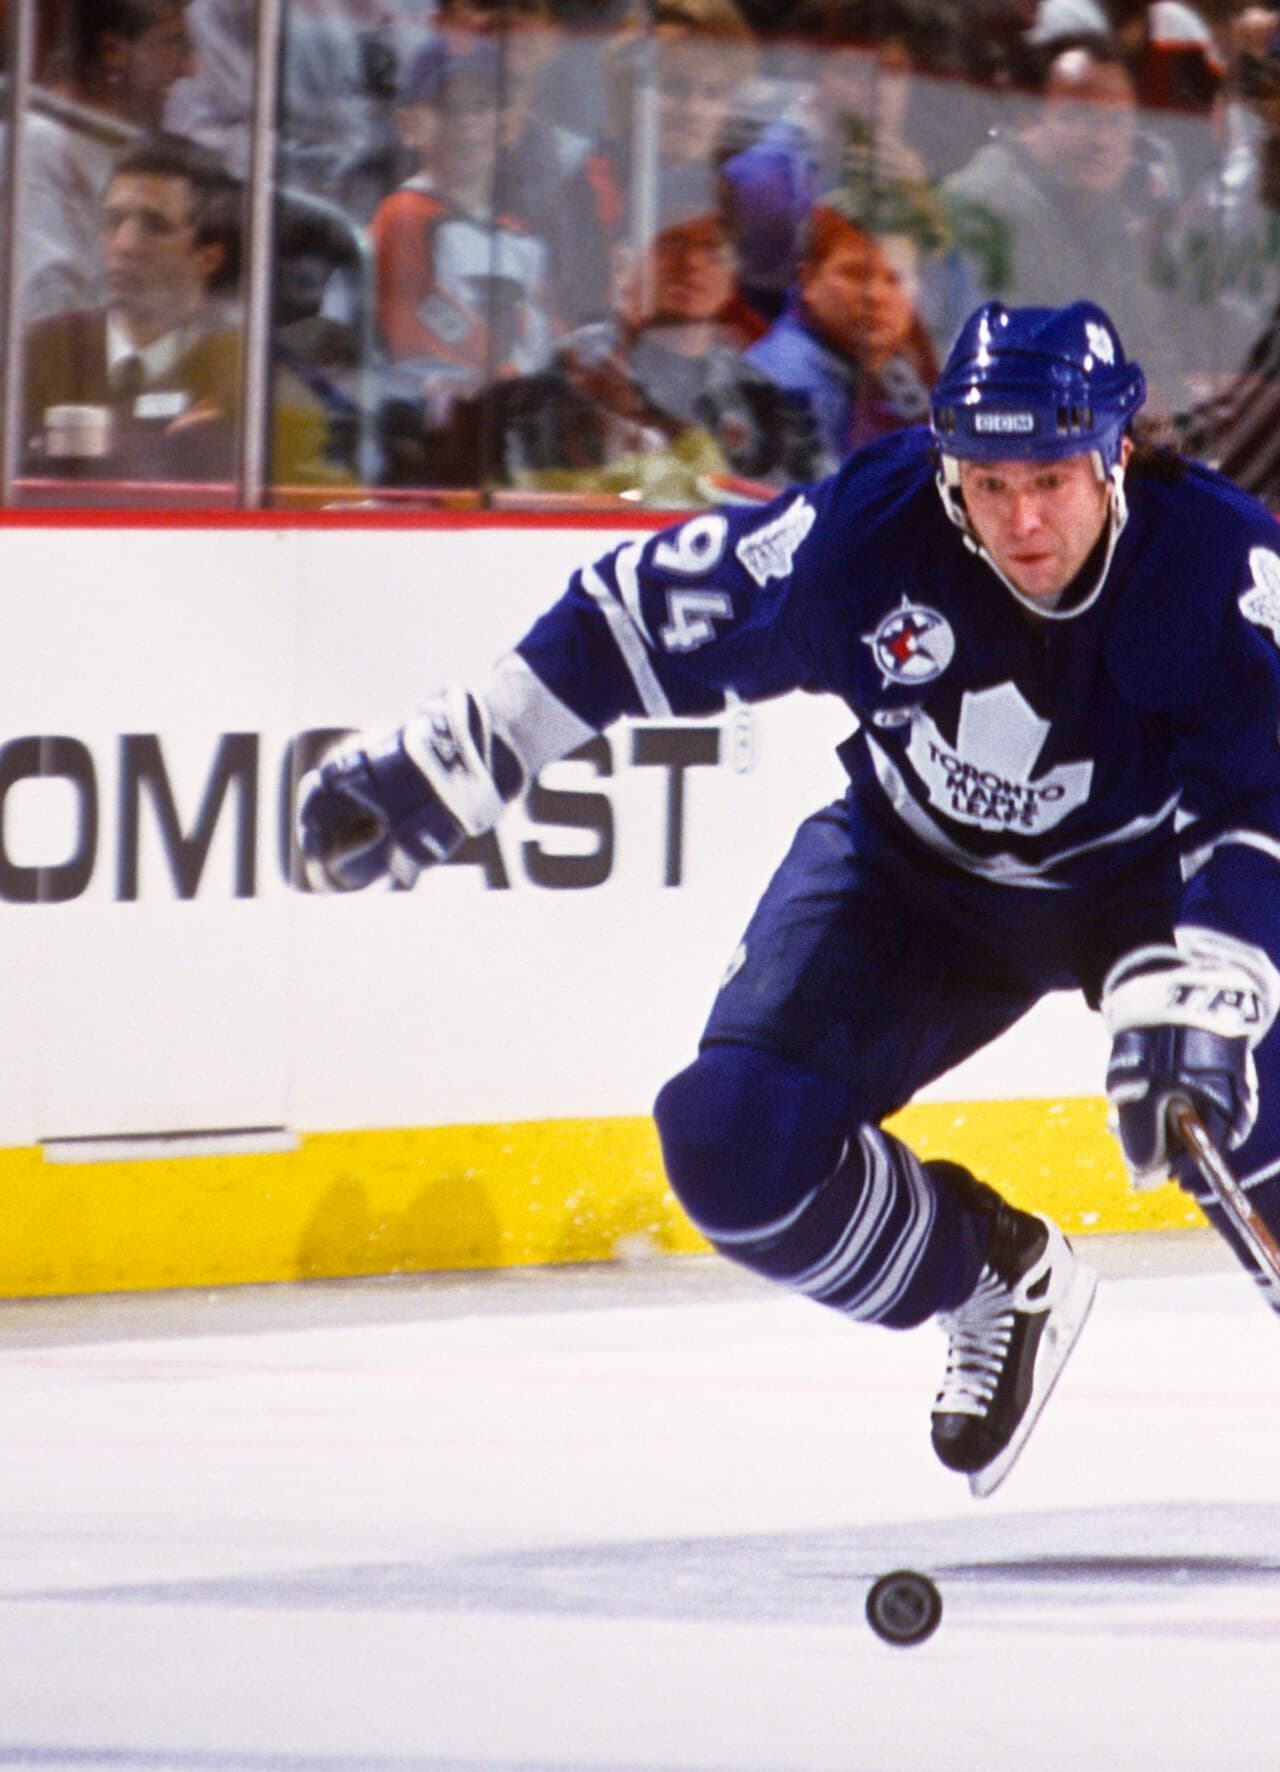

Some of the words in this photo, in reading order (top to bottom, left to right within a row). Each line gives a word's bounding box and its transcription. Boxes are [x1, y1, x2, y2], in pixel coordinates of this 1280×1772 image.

[653, 513, 734, 653] 94
[928, 740, 1066, 802] TORONTO
[946, 773, 1040, 816] MAPLE
[951, 791, 1034, 828] LEAFS
